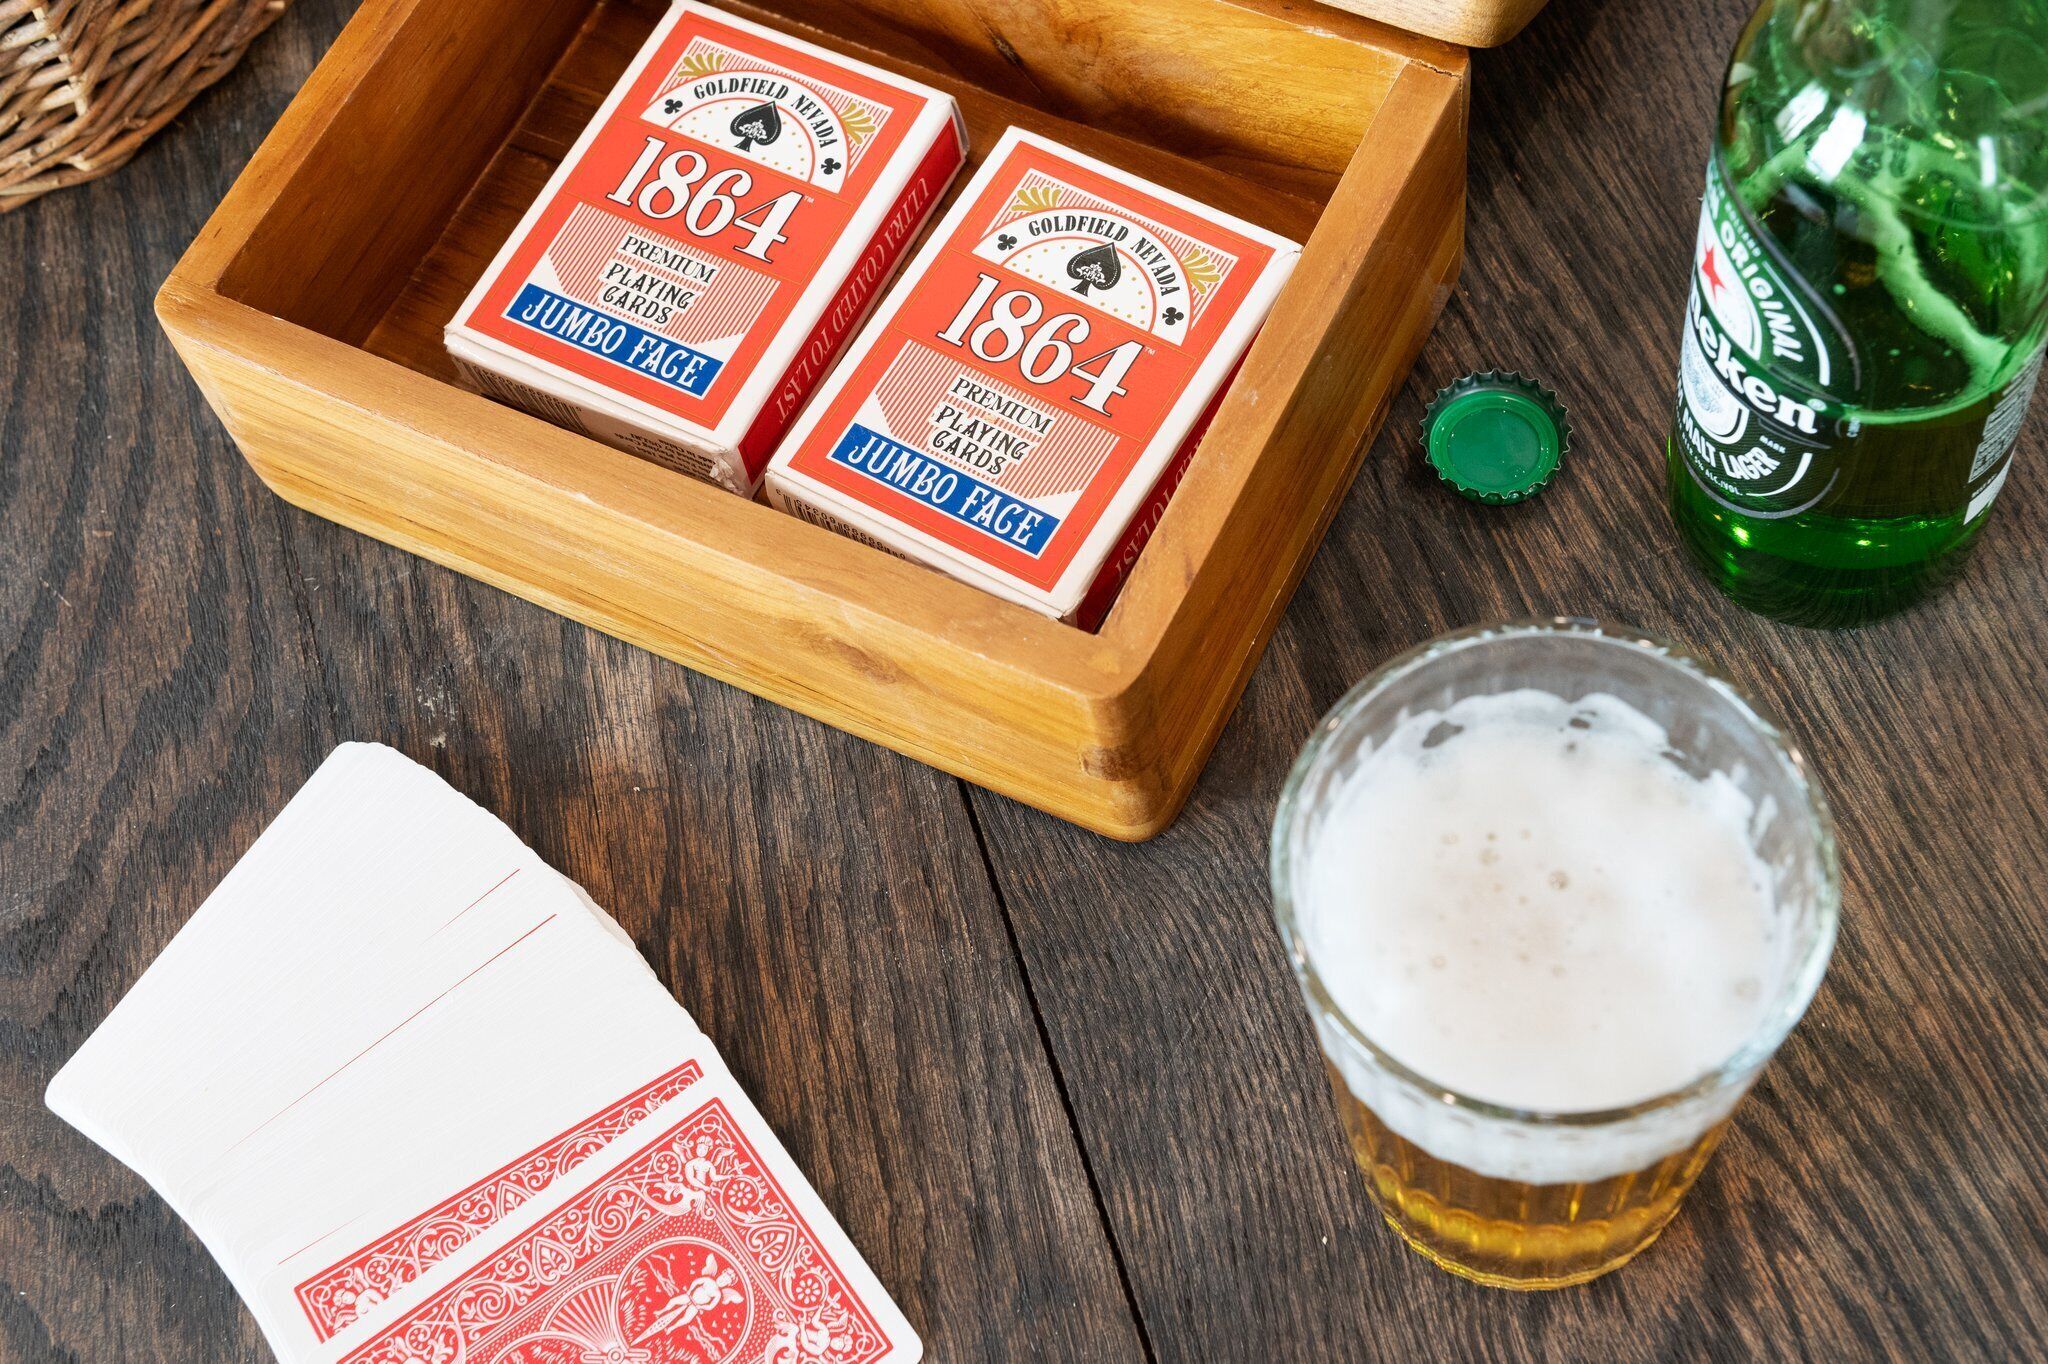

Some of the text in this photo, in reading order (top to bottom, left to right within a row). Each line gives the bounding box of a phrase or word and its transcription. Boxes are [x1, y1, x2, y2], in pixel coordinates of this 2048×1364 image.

[694, 77, 838, 148] GOLDFIELD NEVADA
[605, 135, 804, 265] 1864
[605, 262, 695, 310] PLAYING
[621, 235, 717, 284] PREMIUM
[1028, 215, 1180, 296] GOLDFIELD NEVADA
[1720, 220, 1804, 362] ORIGINAL
[603, 285, 673, 324] CARDS
[776, 177, 929, 424] ULTRA COATED TO LAST
[521, 294, 627, 354] JUMBO
[626, 334, 709, 388] FACE
[935, 272, 1145, 417] 1864
[934, 405, 1030, 461] PLAYING
[951, 377, 1053, 435] PREMIUM
[932, 430, 1007, 475] CARDS
[1683, 407, 1716, 468] MALT
[1719, 447, 1781, 481] LAGER
[847, 435, 1044, 546] JUMBO FACE
